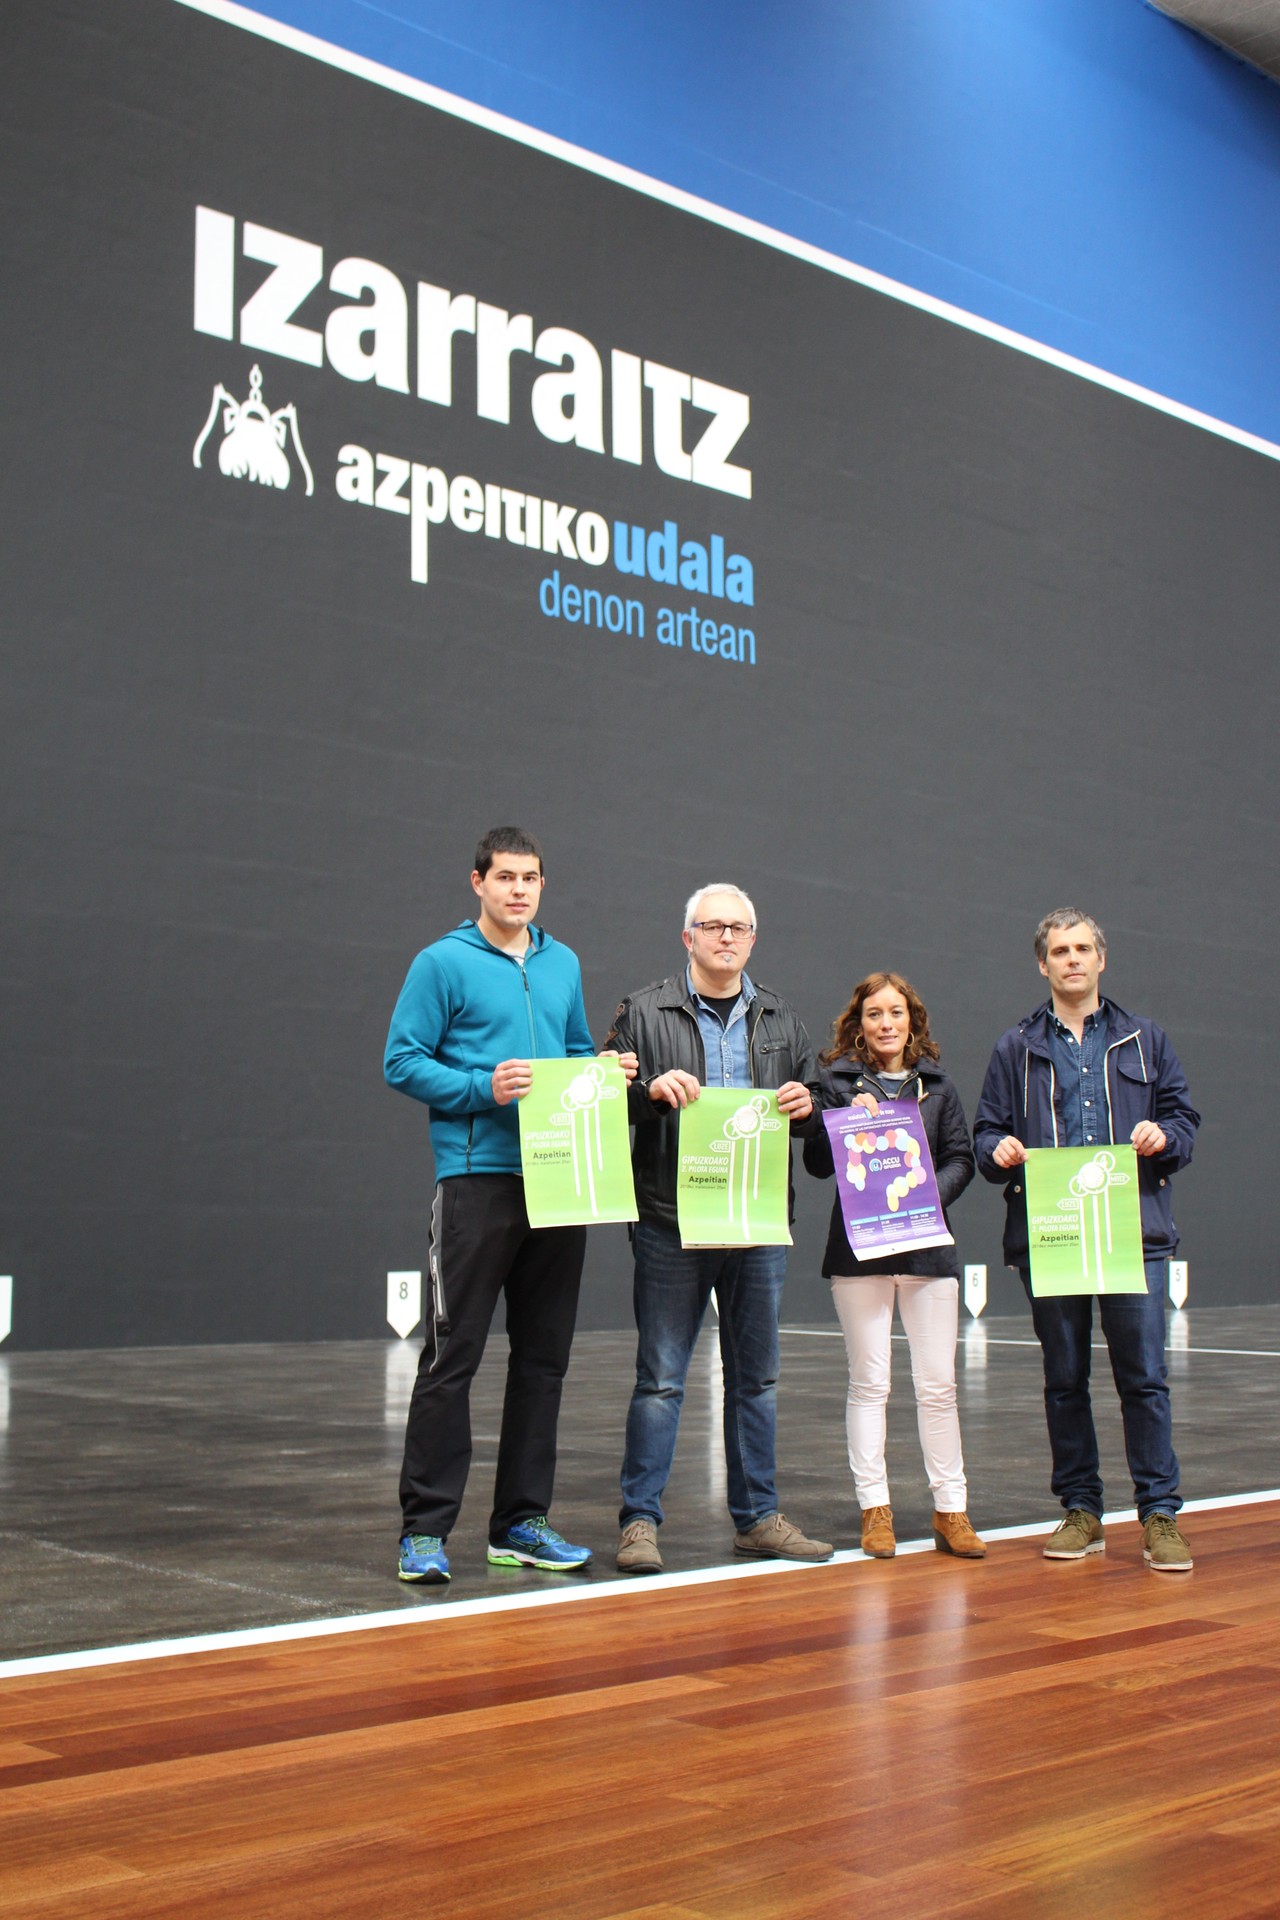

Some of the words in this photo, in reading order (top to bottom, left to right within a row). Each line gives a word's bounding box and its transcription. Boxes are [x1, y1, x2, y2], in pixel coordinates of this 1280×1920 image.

[539, 569, 645, 638] denon
[656, 606, 756, 665] artean
[533, 1150, 571, 1160] Azpeitian
[681, 1155, 729, 1166] GIPUZKOAKO
[882, 1156, 900, 1165] ACCU
[688, 1166, 708, 1174] PILOTA
[709, 1166, 729, 1174] EGUNA
[689, 1175, 728, 1184] Azpeitian
[1032, 1215, 1079, 1225] GIPUZKOAKO
[1040, 1233, 1080, 1243] Azpeitian
[972, 1272, 979, 1287] 6
[1175, 1268, 1181, 1282] 5
[399, 1281, 408, 1300] 8
